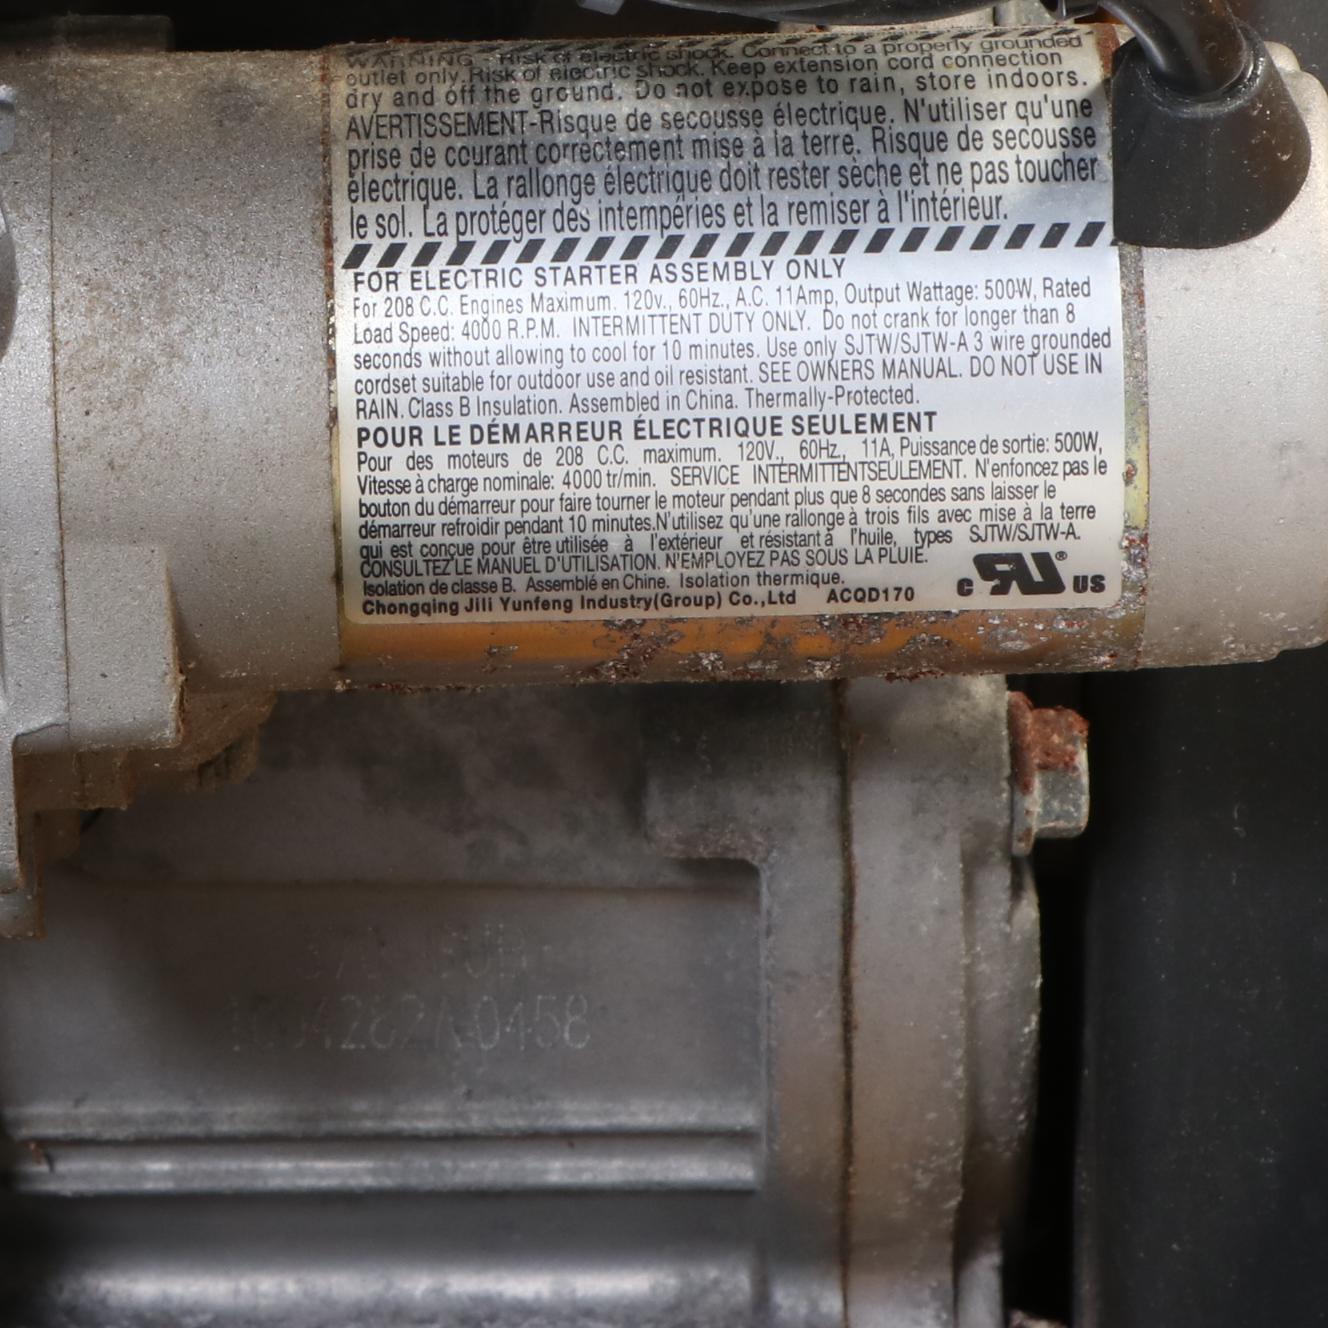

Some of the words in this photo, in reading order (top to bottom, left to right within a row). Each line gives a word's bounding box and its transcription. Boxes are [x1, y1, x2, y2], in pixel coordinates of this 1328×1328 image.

[345, 109, 616, 146] AVERTISSEMENT-Risque
[625, 108, 651, 131] de
[660, 111, 763, 130] secousse
[772, 101, 894, 133] électrique.
[903, 98, 1007, 123] N'utiliser
[1015, 96, 1093, 125] qu'une
[347, 145, 401, 175] prise
[409, 144, 436, 167] de
[444, 143, 528, 166] courant
[534, 138, 684, 163] correctement
[691, 135, 744, 159] mise
[752, 134, 765, 157] à
[773, 133, 794, 156] la
[800, 133, 861, 155] terre.
[871, 129, 948, 159] Risque
[956, 128, 983, 151] de
[992, 130, 1096, 150] secousse
[349, 209, 368, 239] le
[375, 208, 412, 238] sol.
[422, 207, 448, 237] La
[455, 204, 546, 244] protéger
[552, 203, 590, 233] des
[597, 199, 726, 239] intempéries
[733, 201, 753, 228] et
[759, 198, 779, 227] la
[787, 196, 870, 226] remiser
[877, 195, 890, 224] à
[897, 192, 1007, 223] l'intérieur.
[353, 271, 402, 292] FOR
[409, 267, 522, 290] ELECTRIC
[534, 264, 637, 287] STARTER
[649, 260, 774, 283] ASSEMBLY
[785, 258, 845, 280] ONLY
[353, 298, 377, 318] For
[384, 297, 415, 317] 208
[459, 294, 523, 321] Engines
[530, 291, 617, 313] Maximum.
[775, 285, 838, 312] 11Amp,
[844, 283, 900, 310] Output
[906, 281, 978, 309] Wattage:
[1042, 277, 1090, 300] Rated
[356, 426, 423, 448] POUR
[433, 425, 461, 446] LE
[469, 415, 622, 445] DÉMARREUR
[633, 411, 783, 441] ÉLECTRIQUE
[791, 413, 937, 436] SEULEMENT
[361, 598, 459, 619] Chongqing
[463, 598, 492, 613] Jili
[498, 596, 573, 616] Yunfeng
[825, 588, 914, 605] ACQD170
